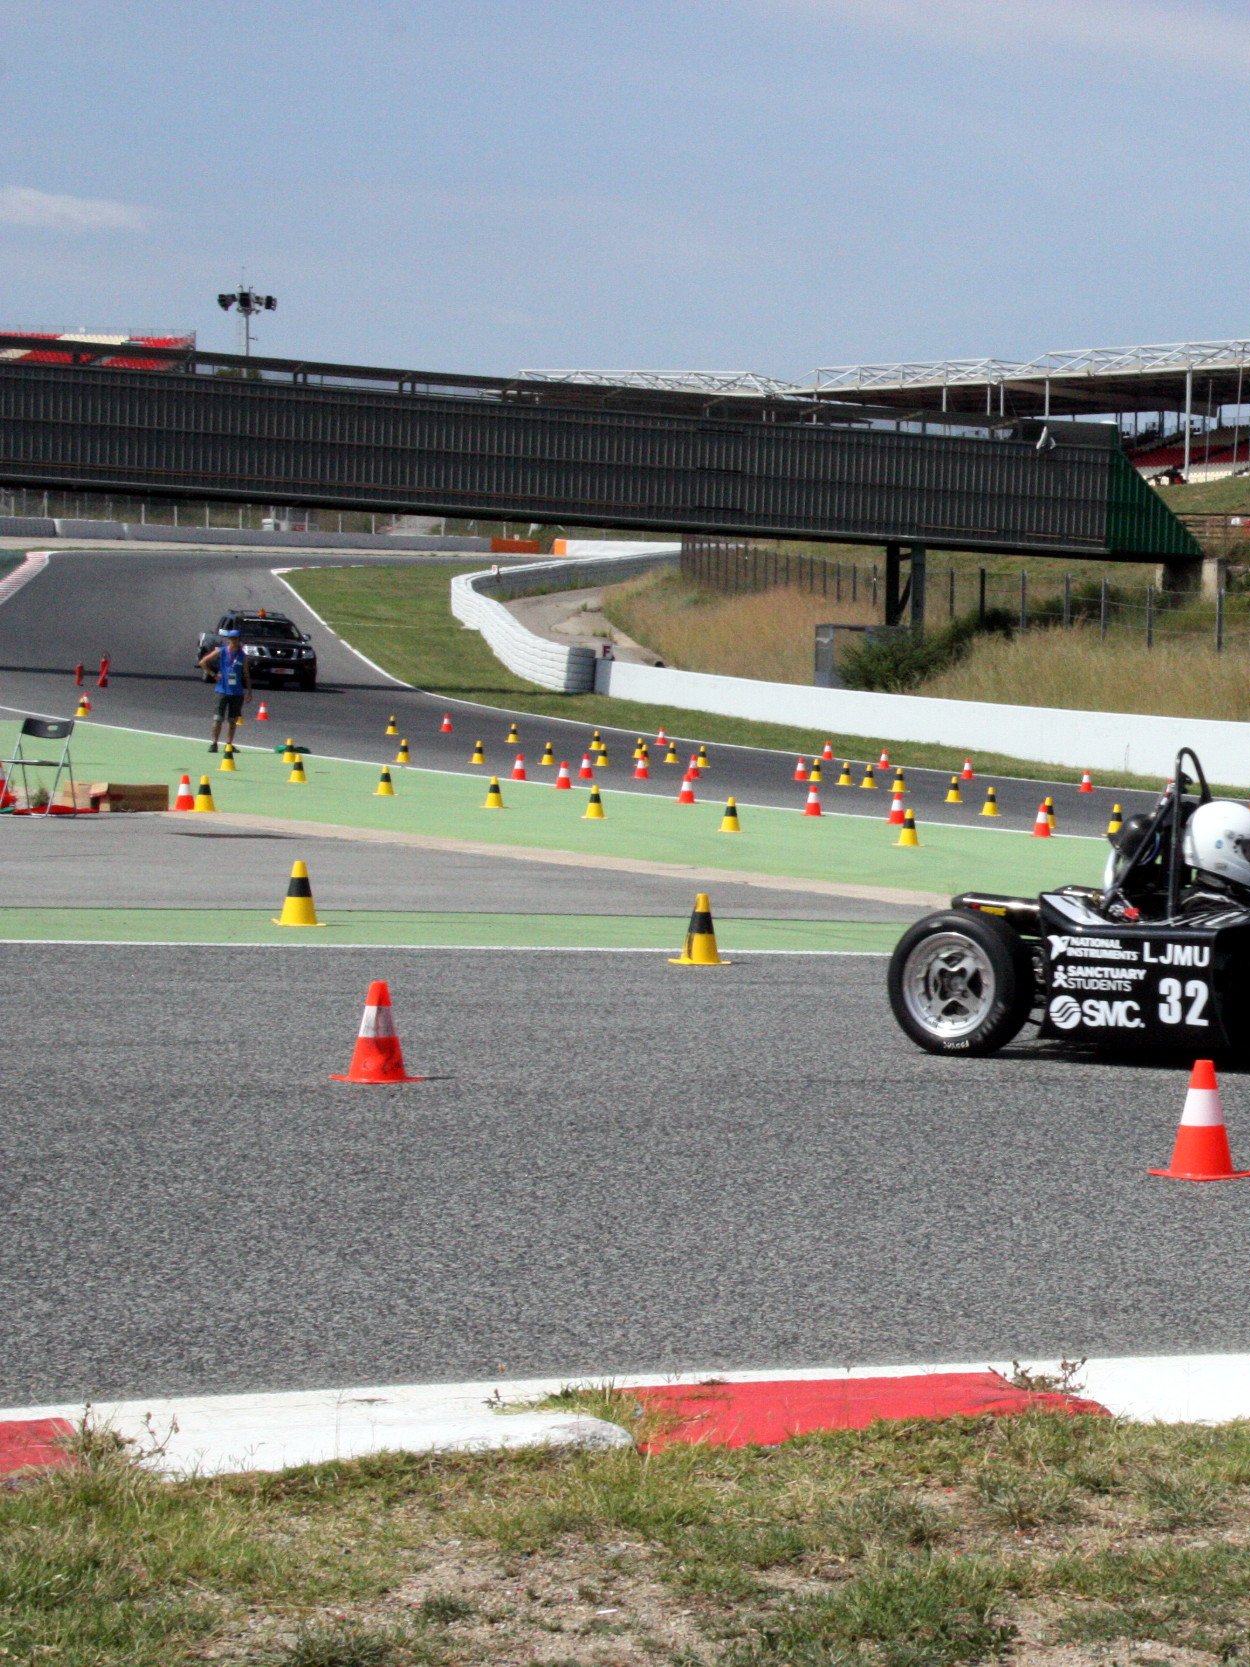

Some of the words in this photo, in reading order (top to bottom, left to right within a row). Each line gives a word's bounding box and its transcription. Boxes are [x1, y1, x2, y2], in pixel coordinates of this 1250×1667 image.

[603, 645, 611, 657] F
[1070, 936, 1122, 949] NATIONAL
[1066, 947, 1140, 961] INSTRUMENTS
[1143, 941, 1210, 967] LJMU
[1067, 965, 1147, 980] SANCTUARY
[1067, 978, 1132, 992] STUDENTS
[1158, 977, 1209, 1026] 32
